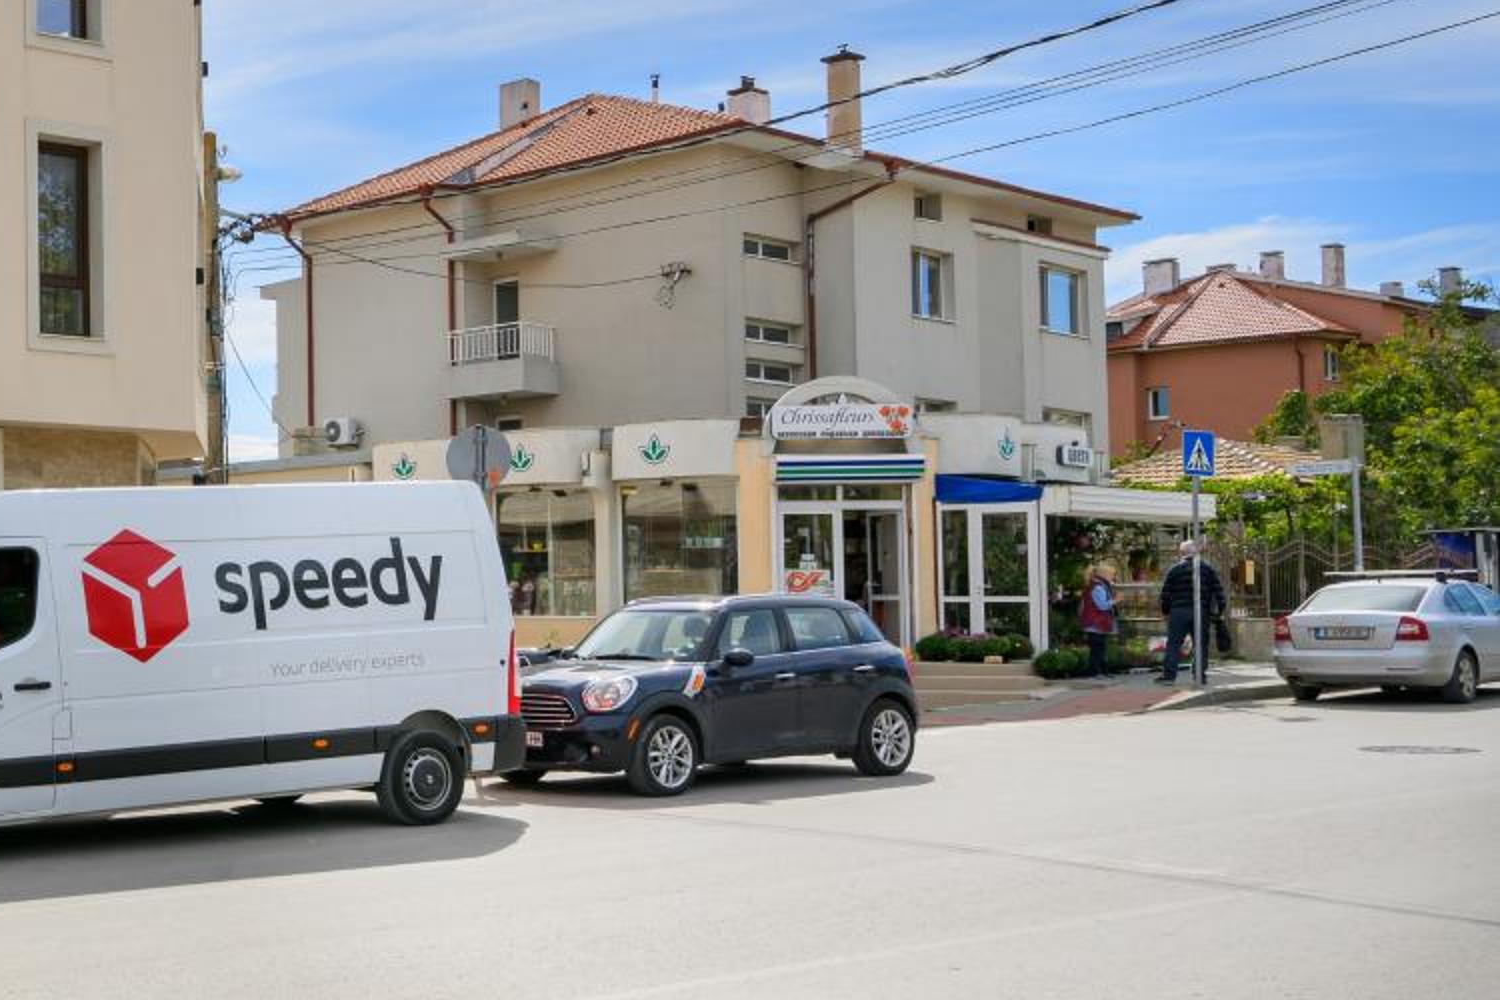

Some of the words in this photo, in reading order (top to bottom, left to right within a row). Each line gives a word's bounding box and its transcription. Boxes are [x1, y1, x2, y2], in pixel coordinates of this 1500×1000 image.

[214, 536, 443, 630] speedy
[271, 662, 308, 677] Your
[309, 653, 367, 676] delivery
[371, 650, 426, 671] experts
